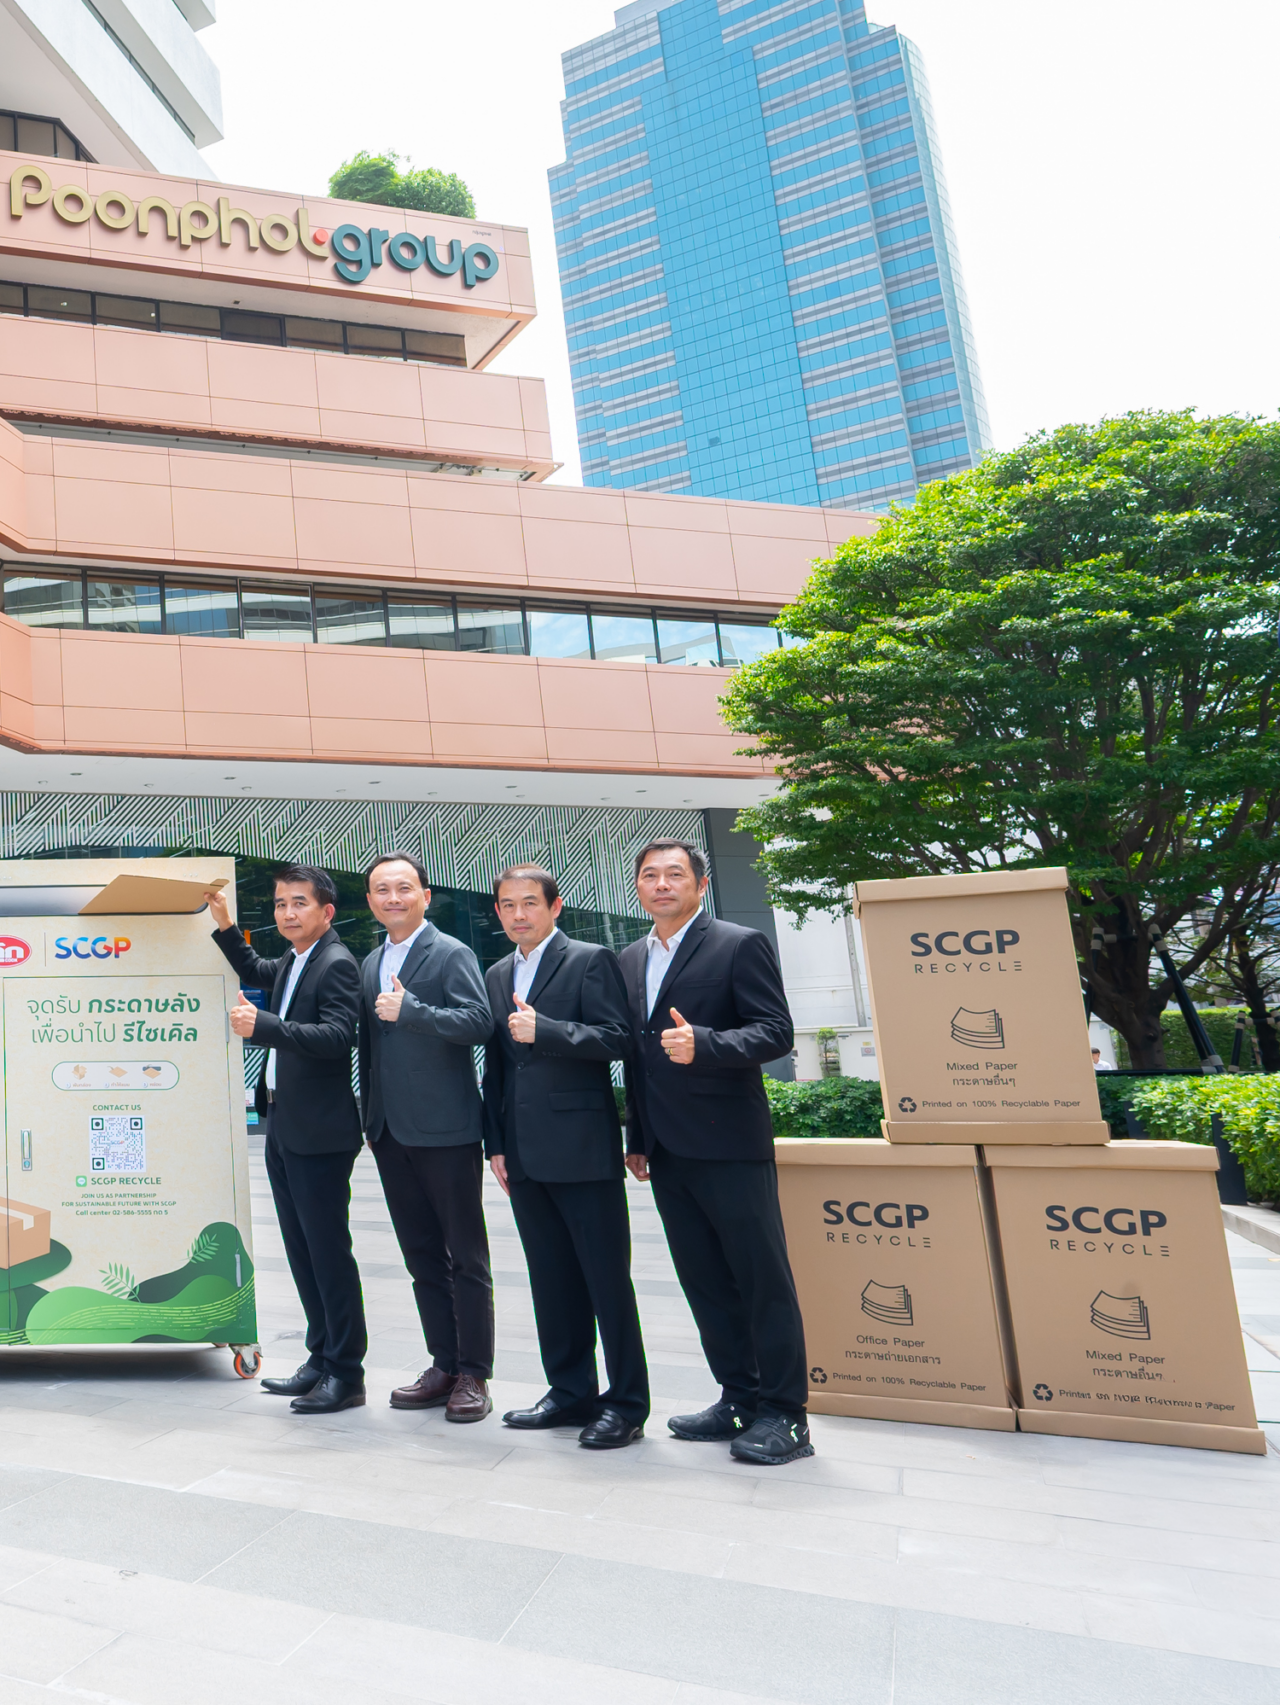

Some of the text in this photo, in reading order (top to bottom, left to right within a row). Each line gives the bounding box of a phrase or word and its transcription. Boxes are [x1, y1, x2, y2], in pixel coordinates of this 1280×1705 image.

[331, 223, 499, 287] group
[55, 936, 131, 960] SCGP
[910, 929, 1020, 957] SCGP
[914, 960, 1022, 974] RECYCLE
[27, 992, 200, 1021] จุดรับ กระดาษลัง
[31, 1018, 198, 1043] เพื่อนำไป รีไซเคิล
[946, 1062, 1018, 1072] Mixed Paper
[922, 1100, 952, 1108] Printed
[972, 1100, 997, 1108] 100%
[1001, 1099, 1050, 1110] Recyclable
[1054, 1099, 1081, 1109] Paper
[91, 1177, 161, 1185] SCGP RECYCLE
[823, 1199, 929, 1229] SCGP
[1045, 1204, 1167, 1237] SCGP
[826, 1231, 931, 1248] RECYCLE
[1049, 1239, 1170, 1257] RECYCLE
[856, 1334, 925, 1348] Office Paper
[845, 1350, 941, 1364] กระดาษถ่ายเอกสาร
[1086, 1350, 1166, 1365] Mixed Paper
[832, 1372, 862, 1382] Printed
[881, 1376, 905, 1385] 100%
[909, 1378, 956, 1389] Recyclable
[960, 1382, 987, 1391] Paper
